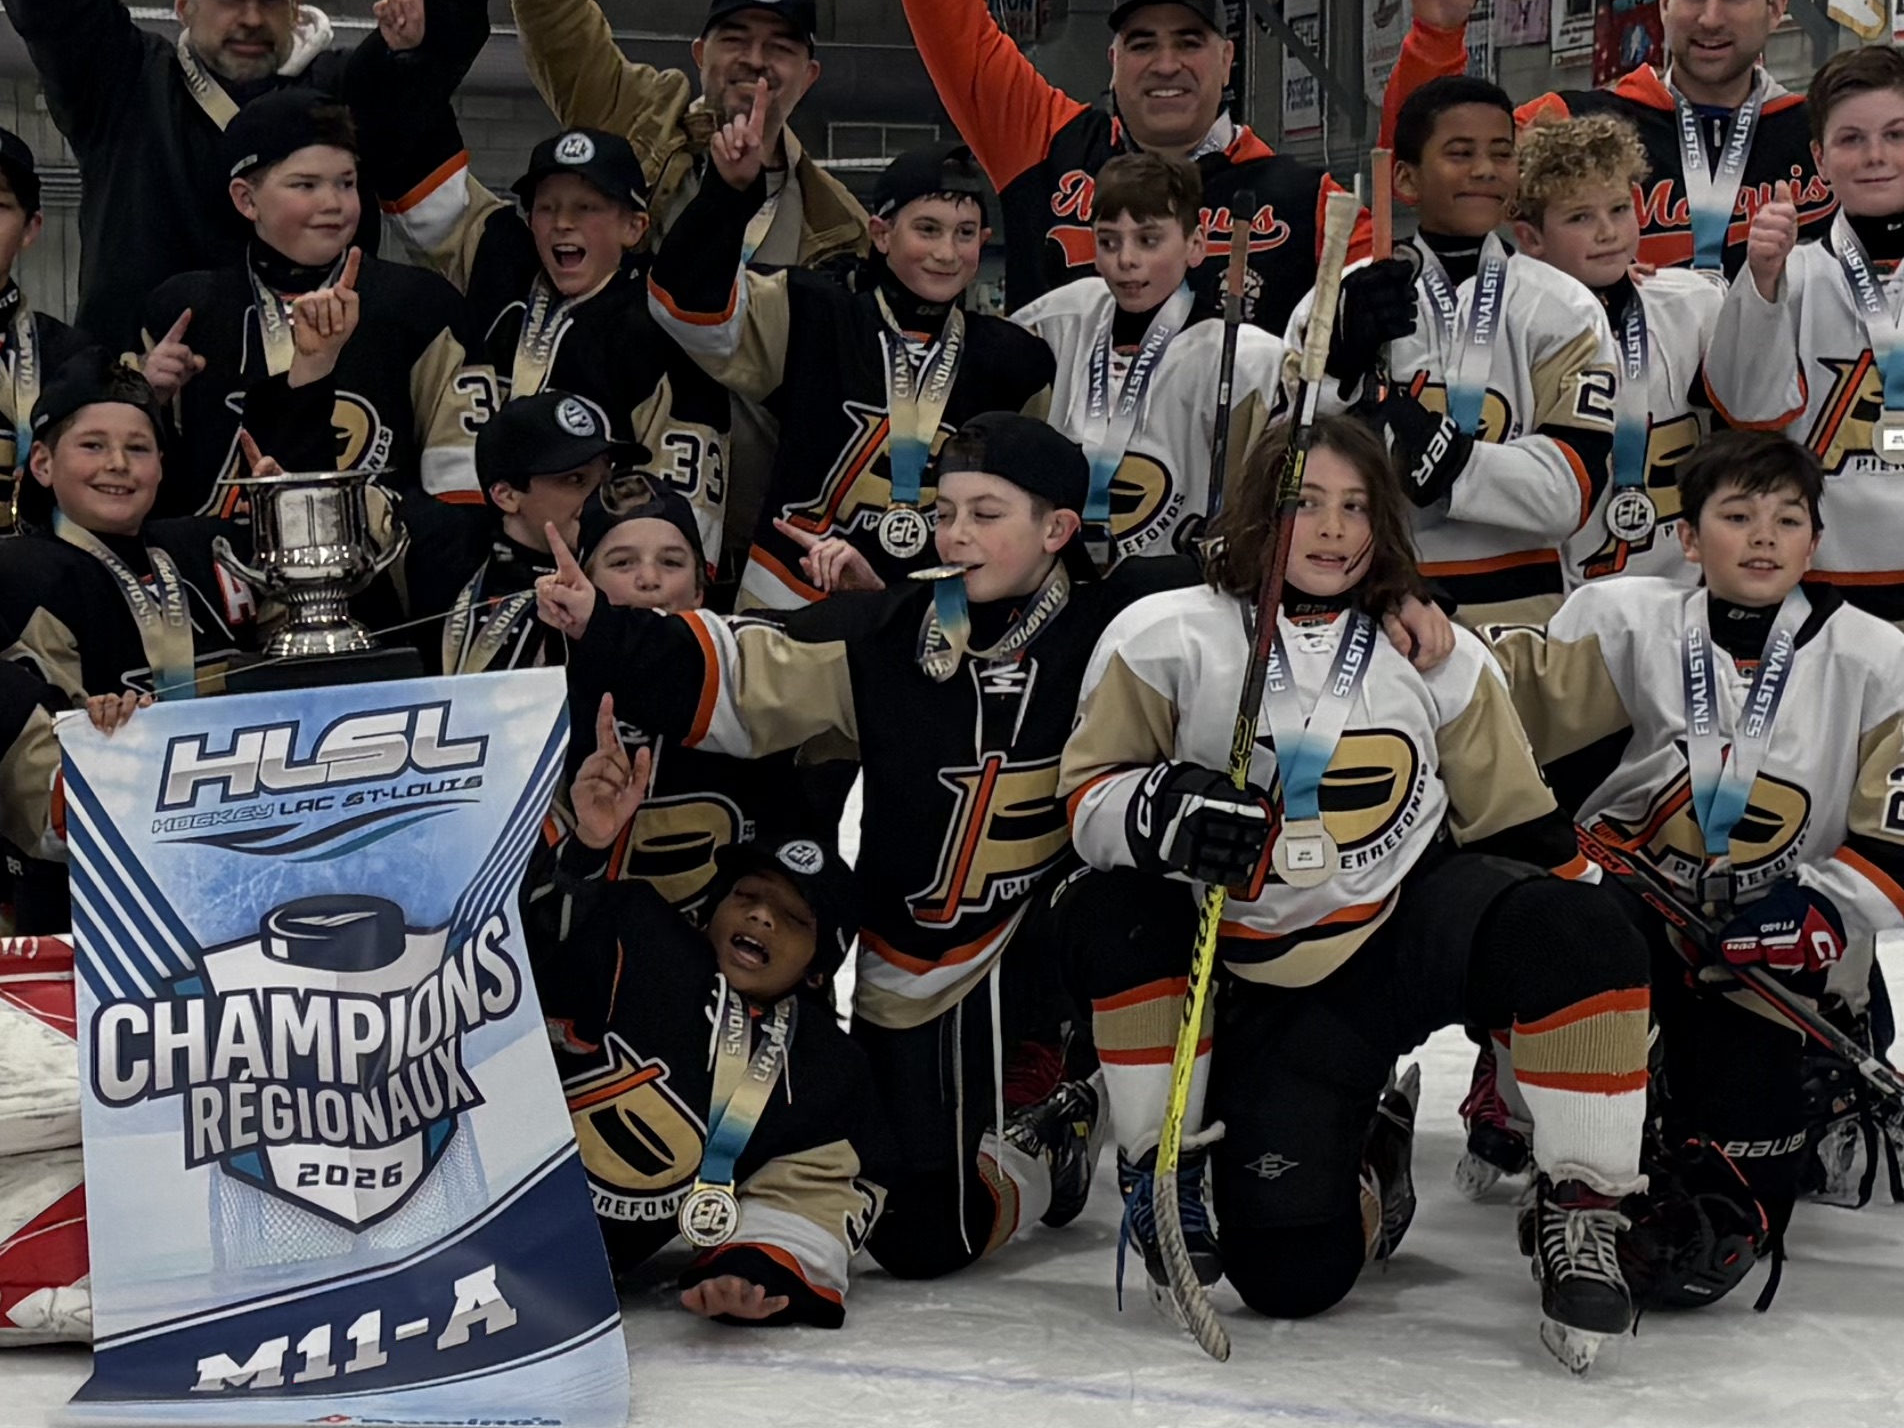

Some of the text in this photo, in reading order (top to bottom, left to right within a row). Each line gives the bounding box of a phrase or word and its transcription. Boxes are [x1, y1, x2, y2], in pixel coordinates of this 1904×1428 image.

[1125, 491, 1186, 557] EFONDS
[1685, 625, 1711, 737] FINALISTES
[1745, 628, 1794, 739] FINALISTES
[151, 775, 484, 835] HOCKEY LAC ST-LOUIS
[156, 700, 489, 812] HLSL
[1340, 763, 1431, 870] ERREFONDS
[97, 923, 514, 1101] CHAMPIONS
[191, 1047, 473, 1162] RÉGIONAUX
[296, 1160, 403, 1189] 2026
[189, 1263, 518, 1393] M11-A
